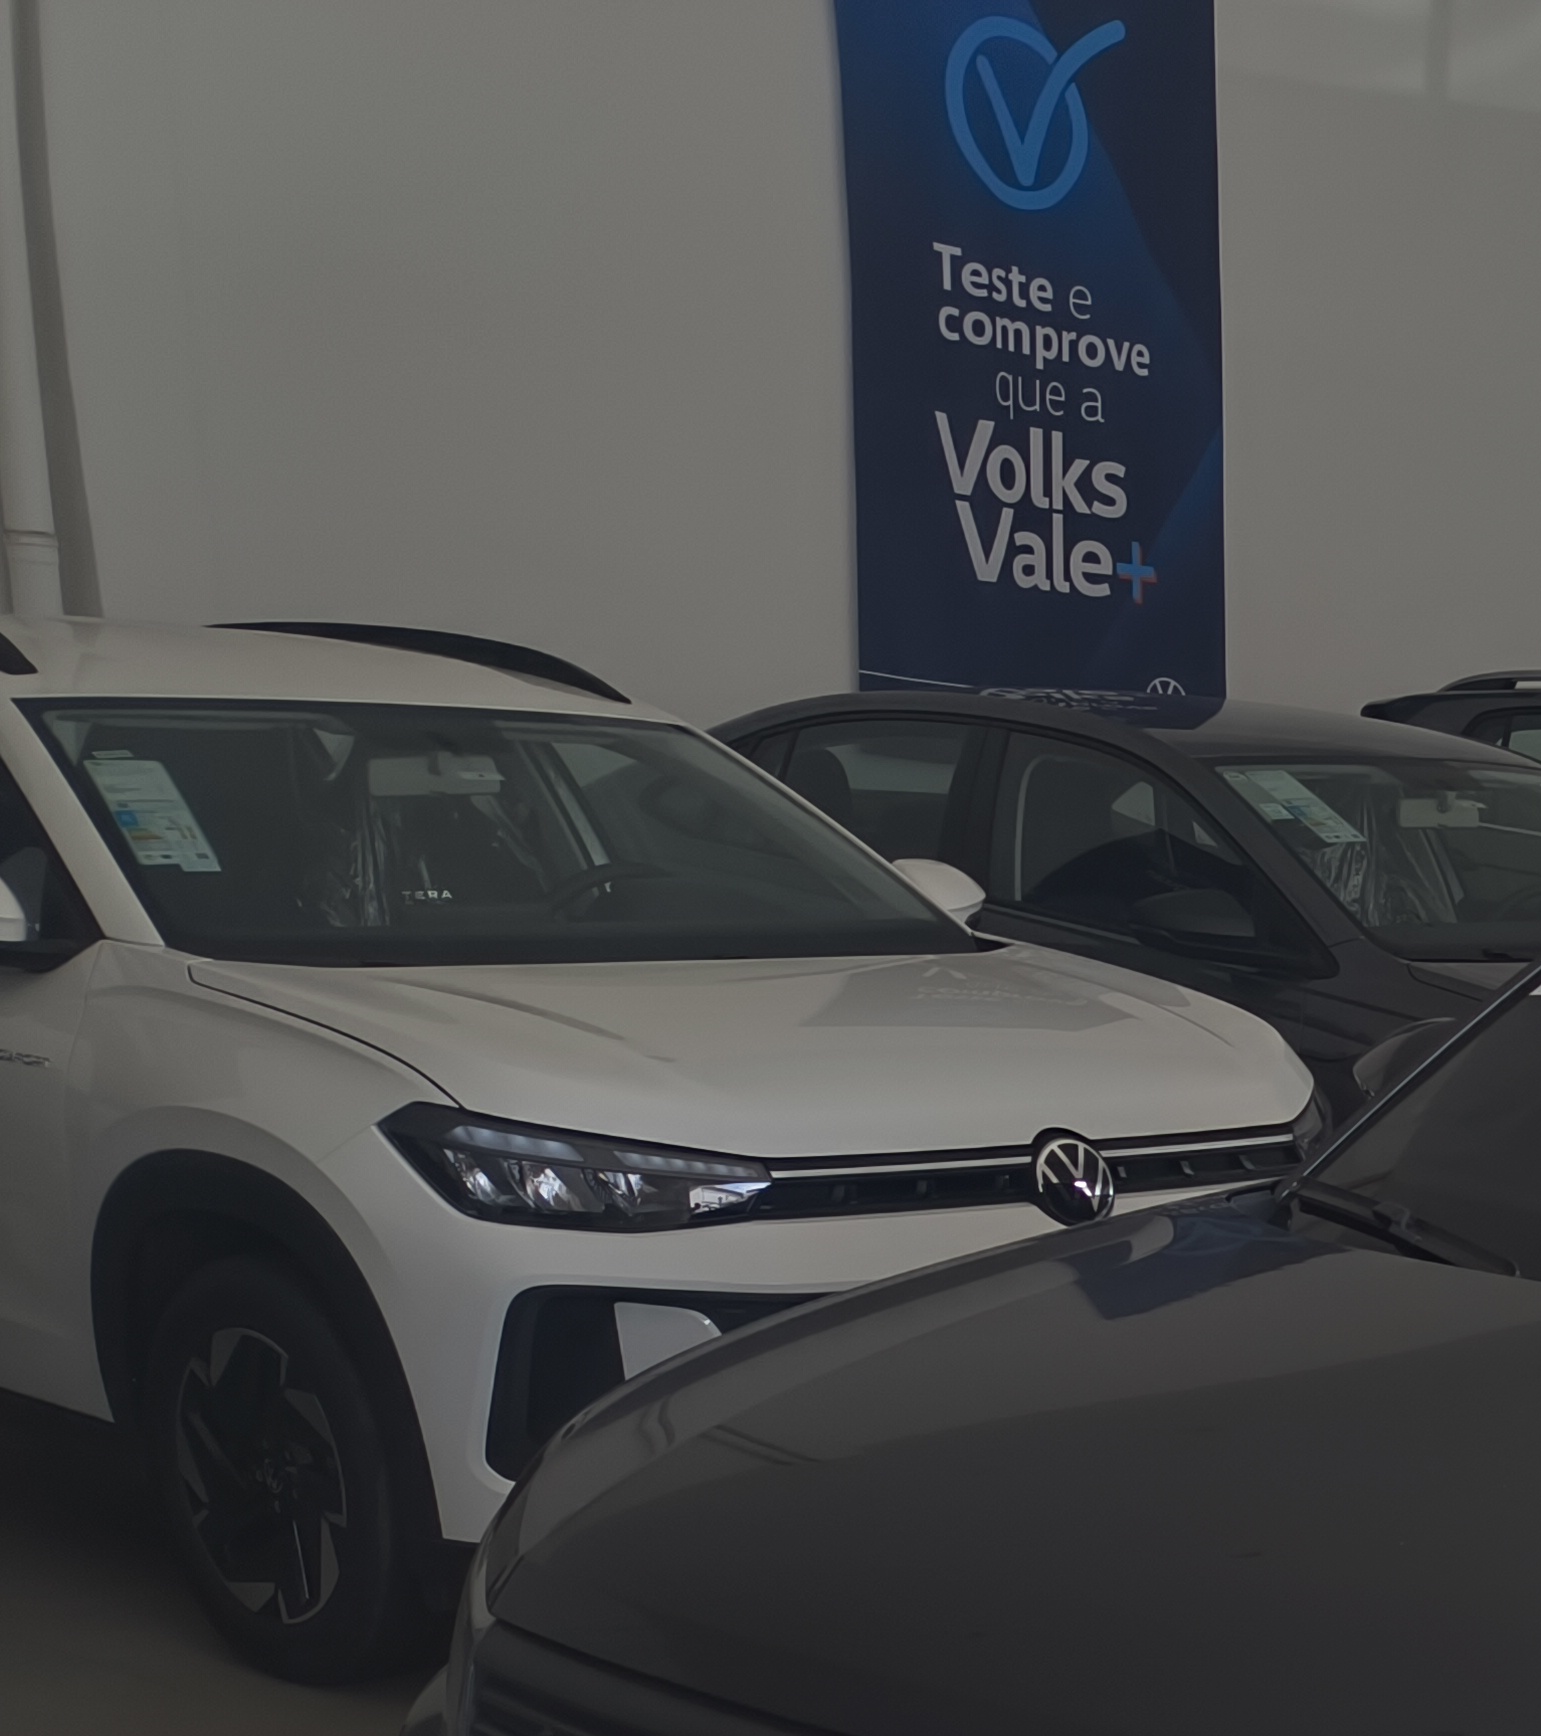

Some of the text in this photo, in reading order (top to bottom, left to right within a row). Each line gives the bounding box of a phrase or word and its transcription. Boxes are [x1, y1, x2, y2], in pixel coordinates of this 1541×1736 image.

[932, 242, 1093, 320] Teste e
[938, 305, 1151, 377] comprove
[995, 370, 1105, 423] que a
[934, 410, 1128, 519] Volks
[955, 499, 1158, 605] Vale+
